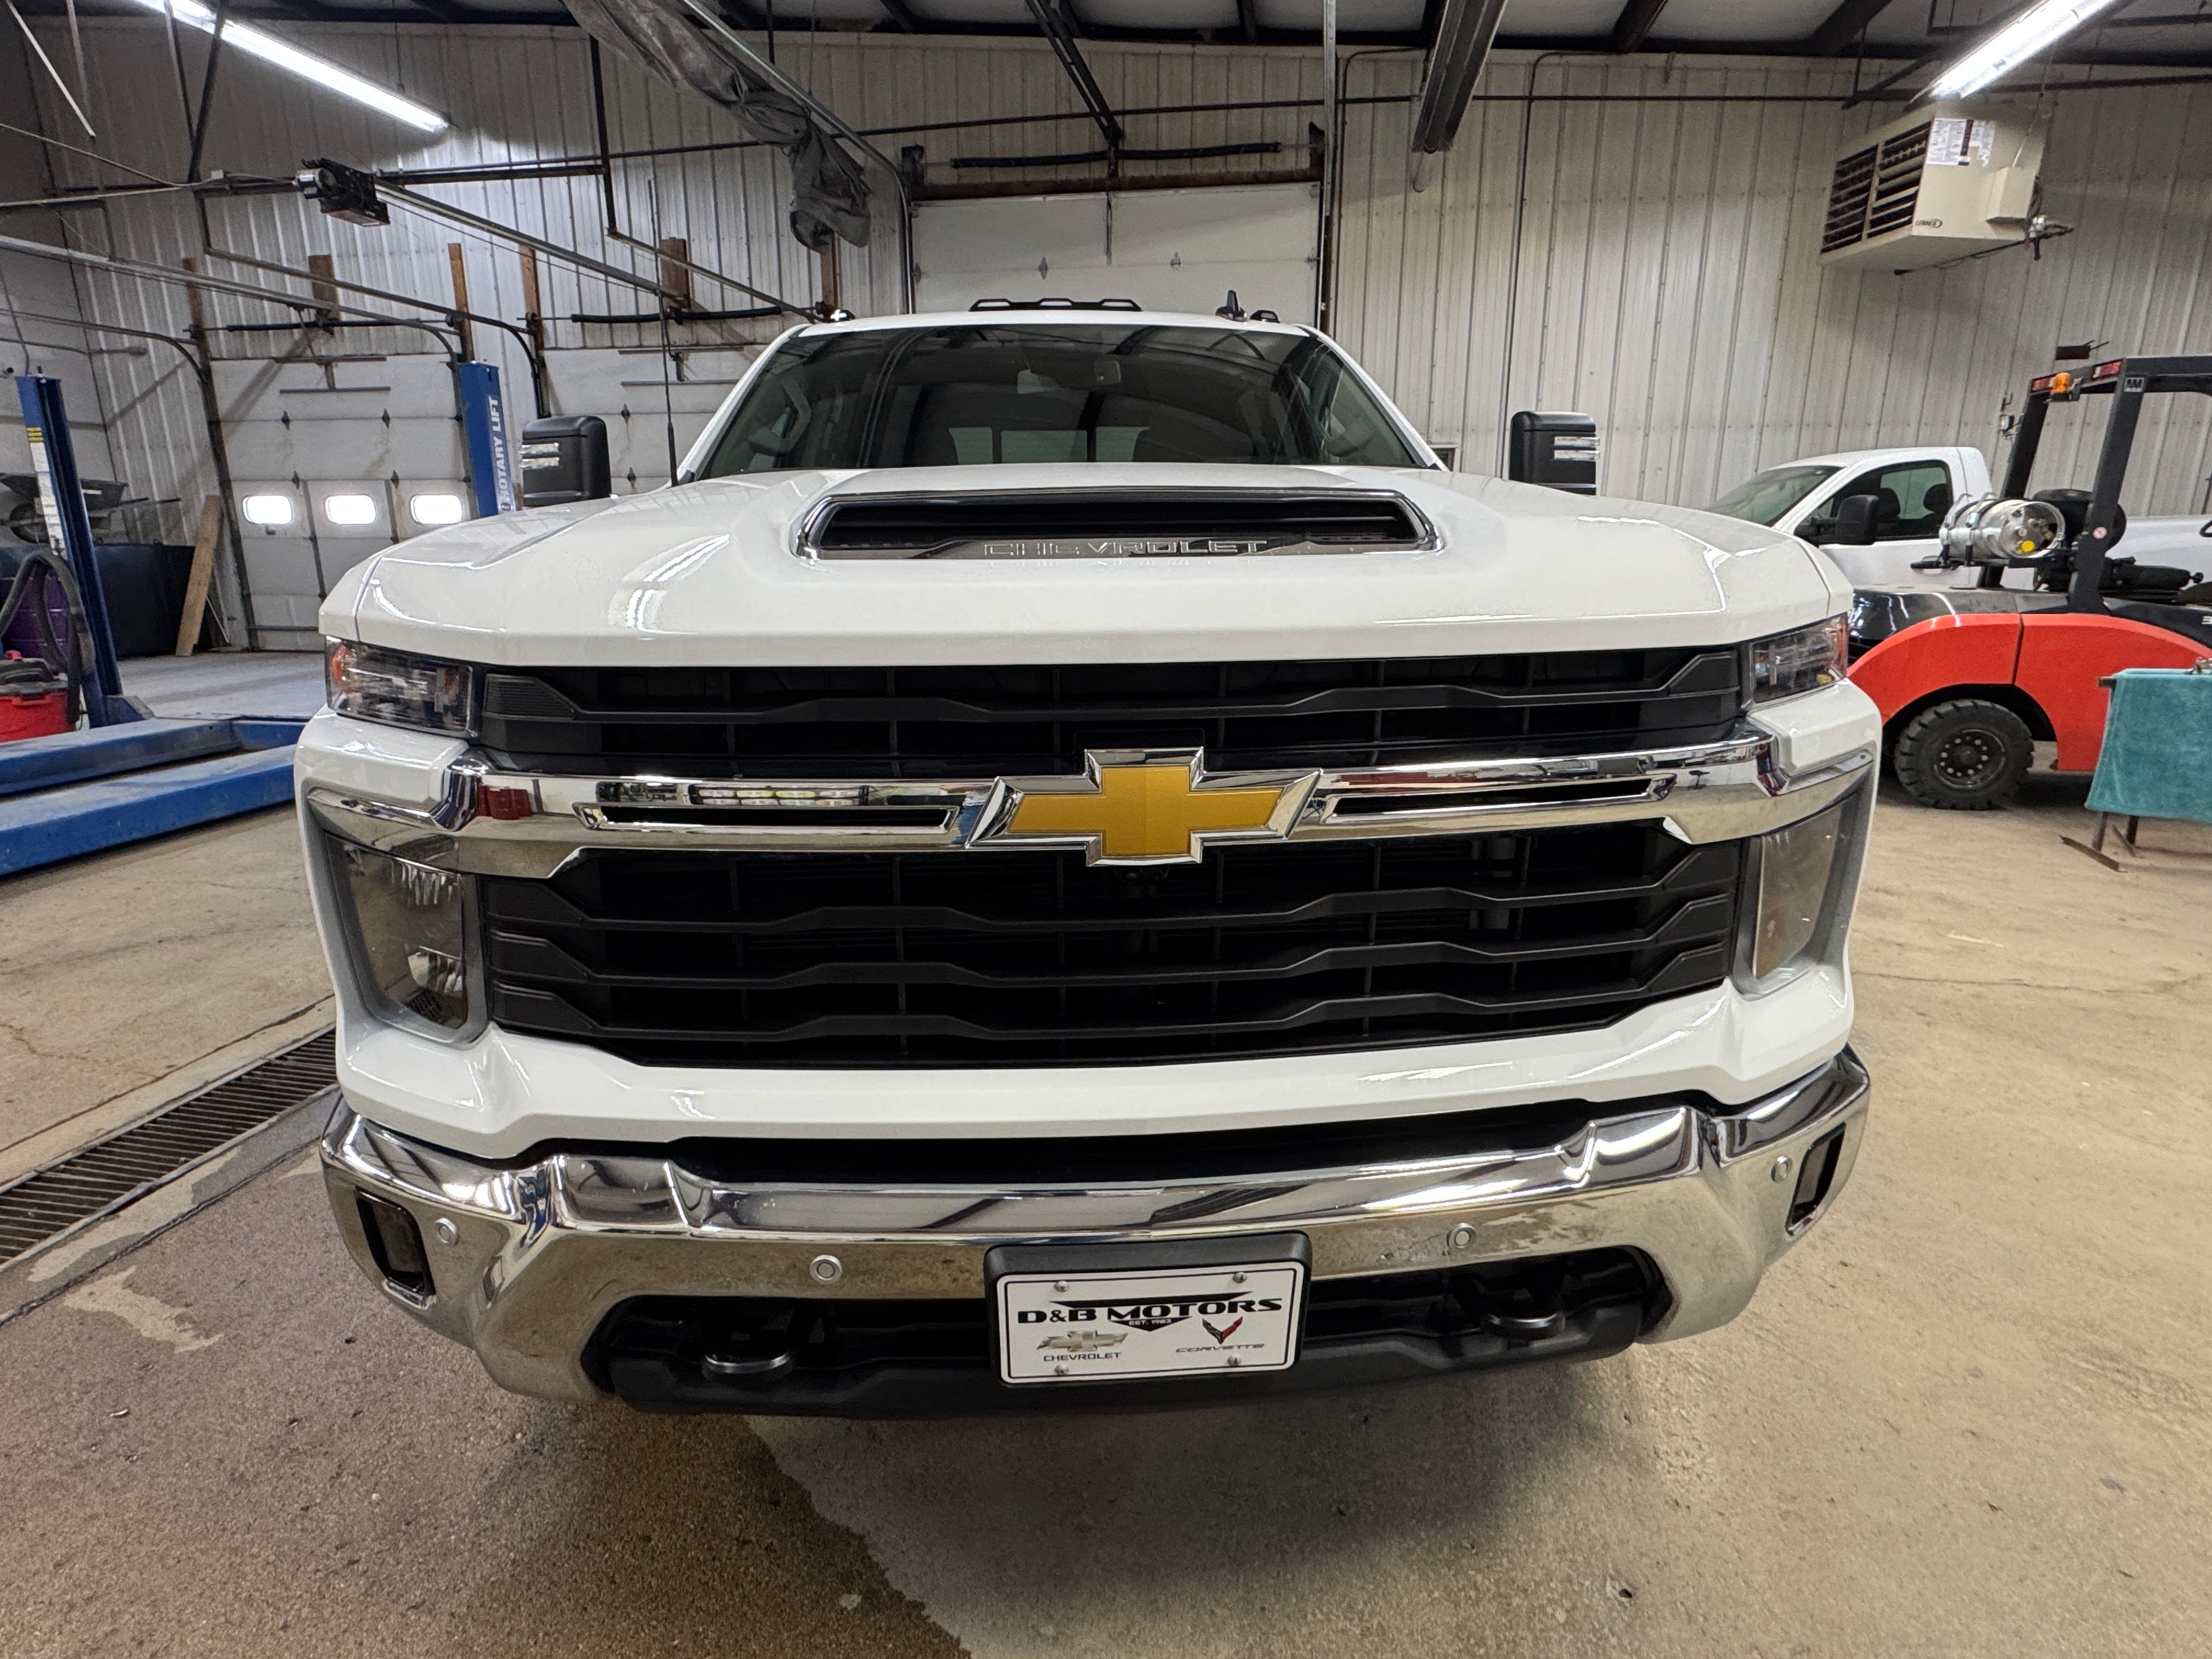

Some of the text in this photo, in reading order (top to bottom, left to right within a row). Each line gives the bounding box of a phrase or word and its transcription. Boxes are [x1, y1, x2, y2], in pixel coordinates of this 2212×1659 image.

[488, 396, 501, 432] LIFT
[984, 540, 1267, 556] CHEVROLET
[1017, 1298, 1283, 1324] D&B MOTORS
[1175, 1342, 1266, 1353] CORVETTE
[1043, 1352, 1121, 1362] CHEVROLET
